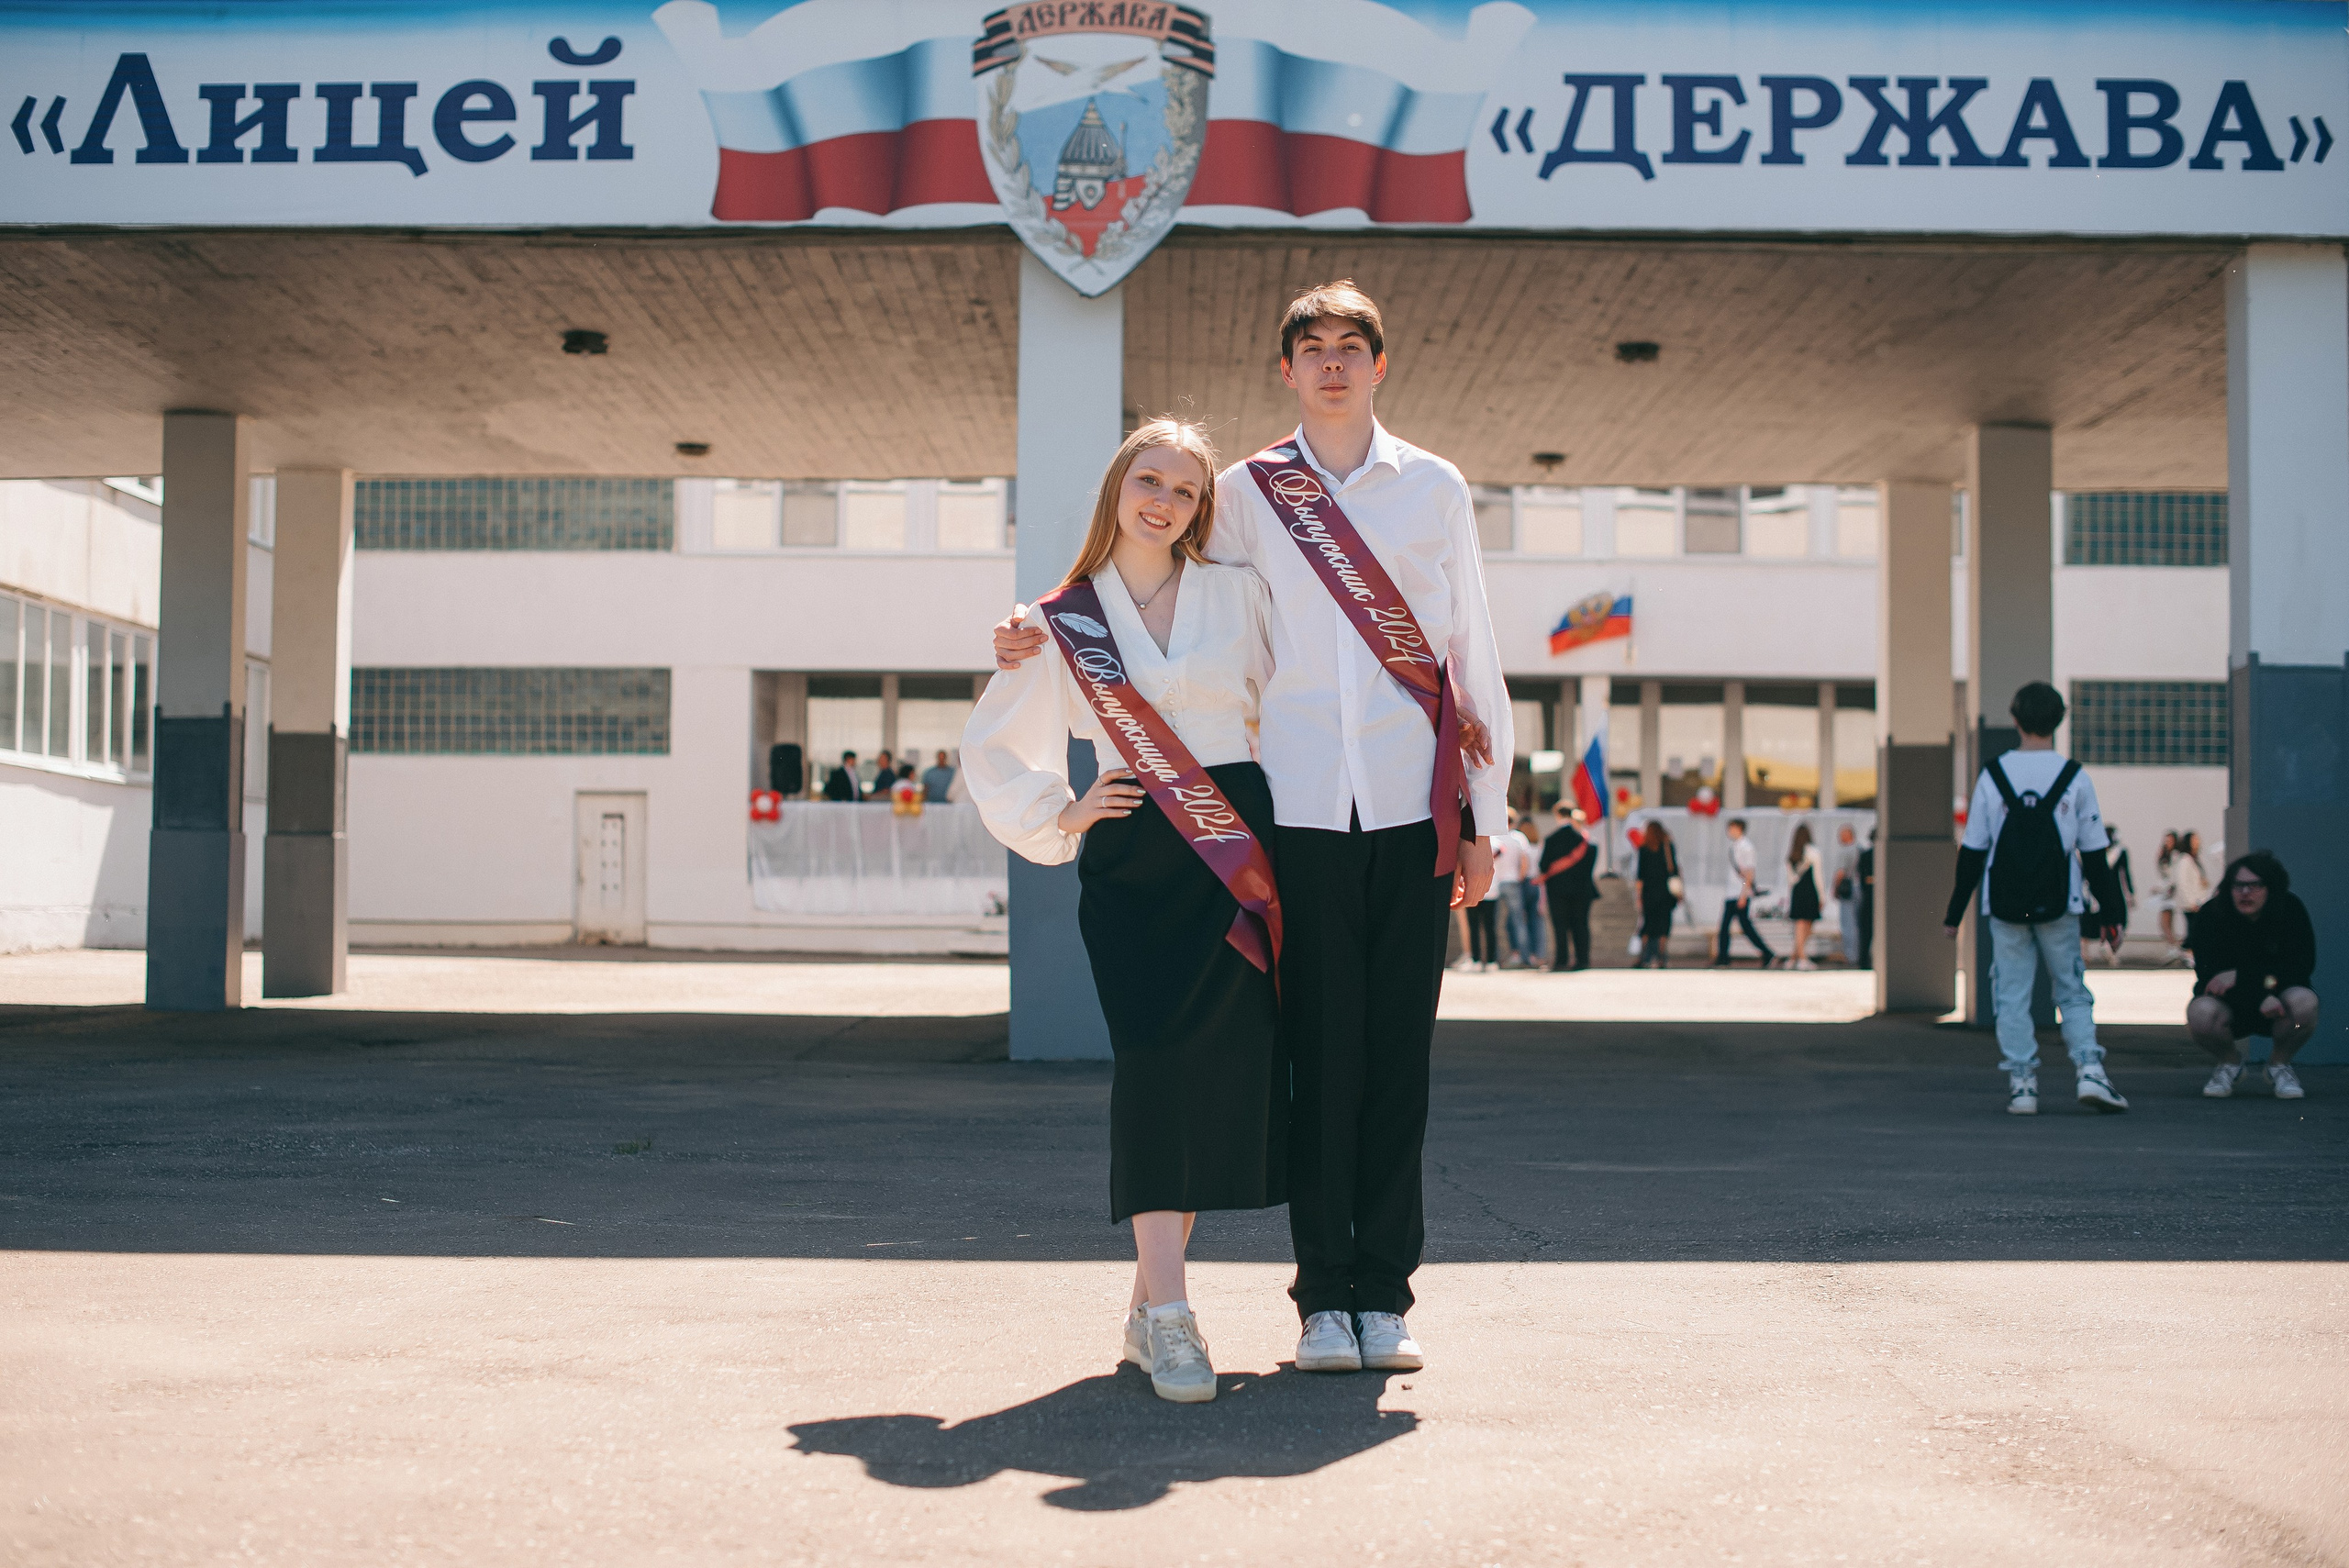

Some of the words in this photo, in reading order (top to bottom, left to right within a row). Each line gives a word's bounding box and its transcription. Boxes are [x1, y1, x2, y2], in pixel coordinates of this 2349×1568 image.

[11, 37, 636, 178] «Лицей
[1490, 72, 2333, 181] «ДЕРЖАВА»
[1268, 469, 1375, 601] Выпускник
[1364, 606, 1435, 665] 2024
[1073, 647, 1180, 783] Выпускница
[1167, 784, 1251, 843] 2024
